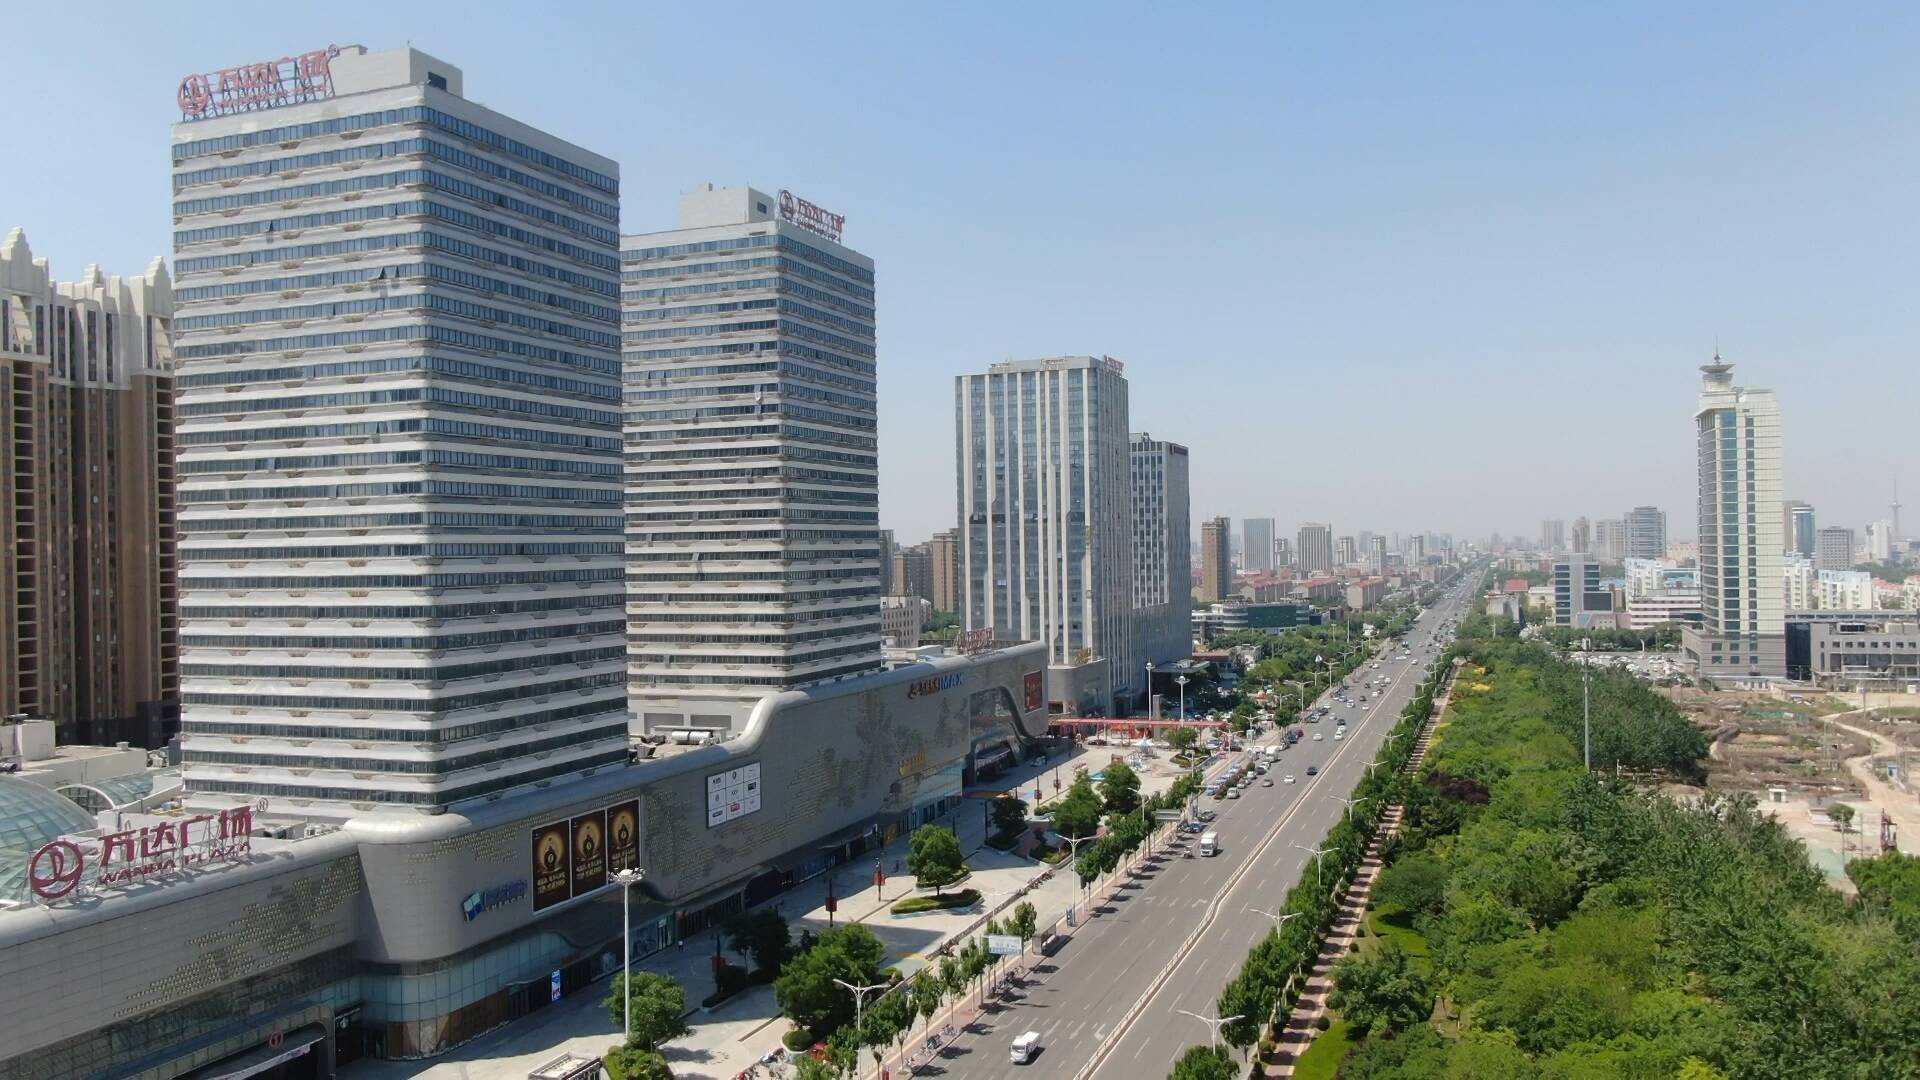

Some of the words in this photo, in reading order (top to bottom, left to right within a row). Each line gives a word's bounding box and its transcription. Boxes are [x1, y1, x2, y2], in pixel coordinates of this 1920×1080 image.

[98, 805, 252, 867] 万达广场
[98, 859, 177, 885] WANDA
[184, 841, 252, 864] PLAZA
